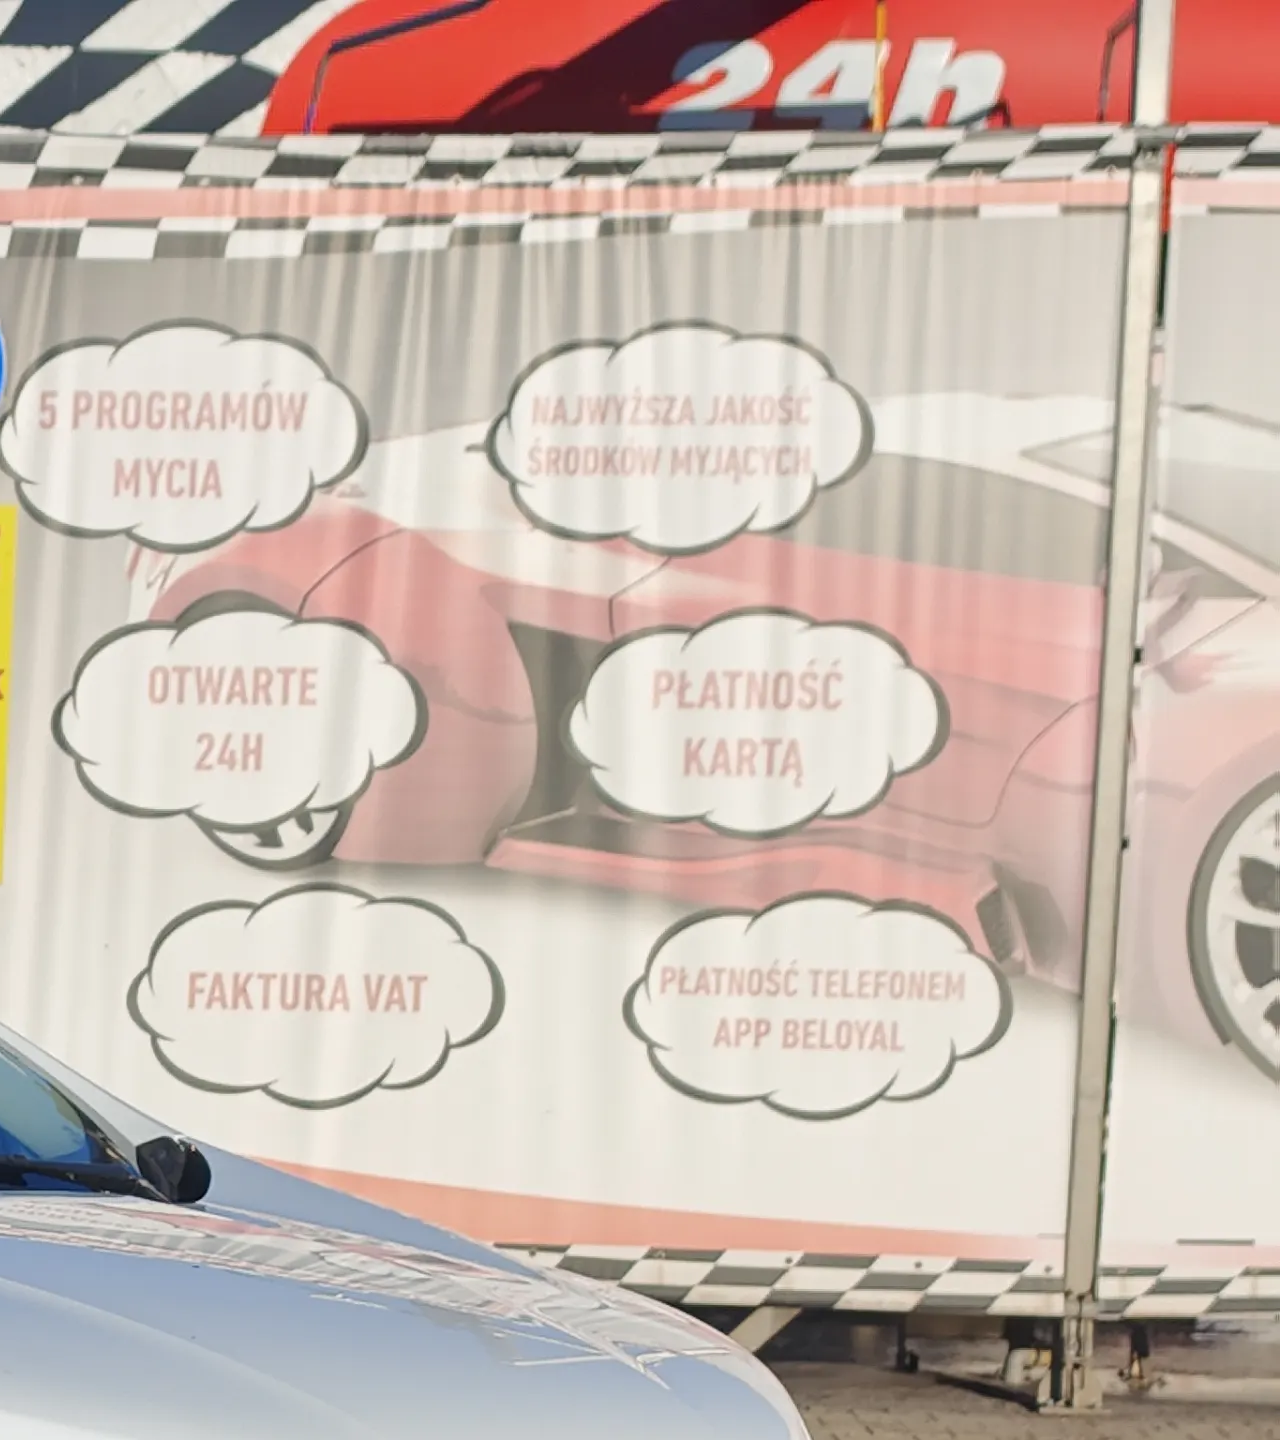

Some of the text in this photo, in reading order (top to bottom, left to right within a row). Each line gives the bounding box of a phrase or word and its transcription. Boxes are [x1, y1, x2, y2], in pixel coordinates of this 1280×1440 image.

[656, 38, 1006, 130] 24h
[39, 379, 309, 432] 5 PROGRAMÓW
[531, 385, 813, 427] NAJWYŻSZA JAKOŚĆ
[113, 458, 224, 499] MYCIA
[527, 437, 813, 484] ŚRODKÓW MYJĄCYCH
[147, 664, 319, 706] OTWARTE
[651, 658, 845, 710] PŁATNOŚĆ
[194, 732, 265, 772] 24H
[683, 736, 805, 789] KARTĄ
[187, 970, 429, 1014] FAKTURA VAT
[659, 958, 967, 1002] PŁATNOŚĆ TELEFONEM
[712, 1016, 906, 1053] APP BELOYAL
